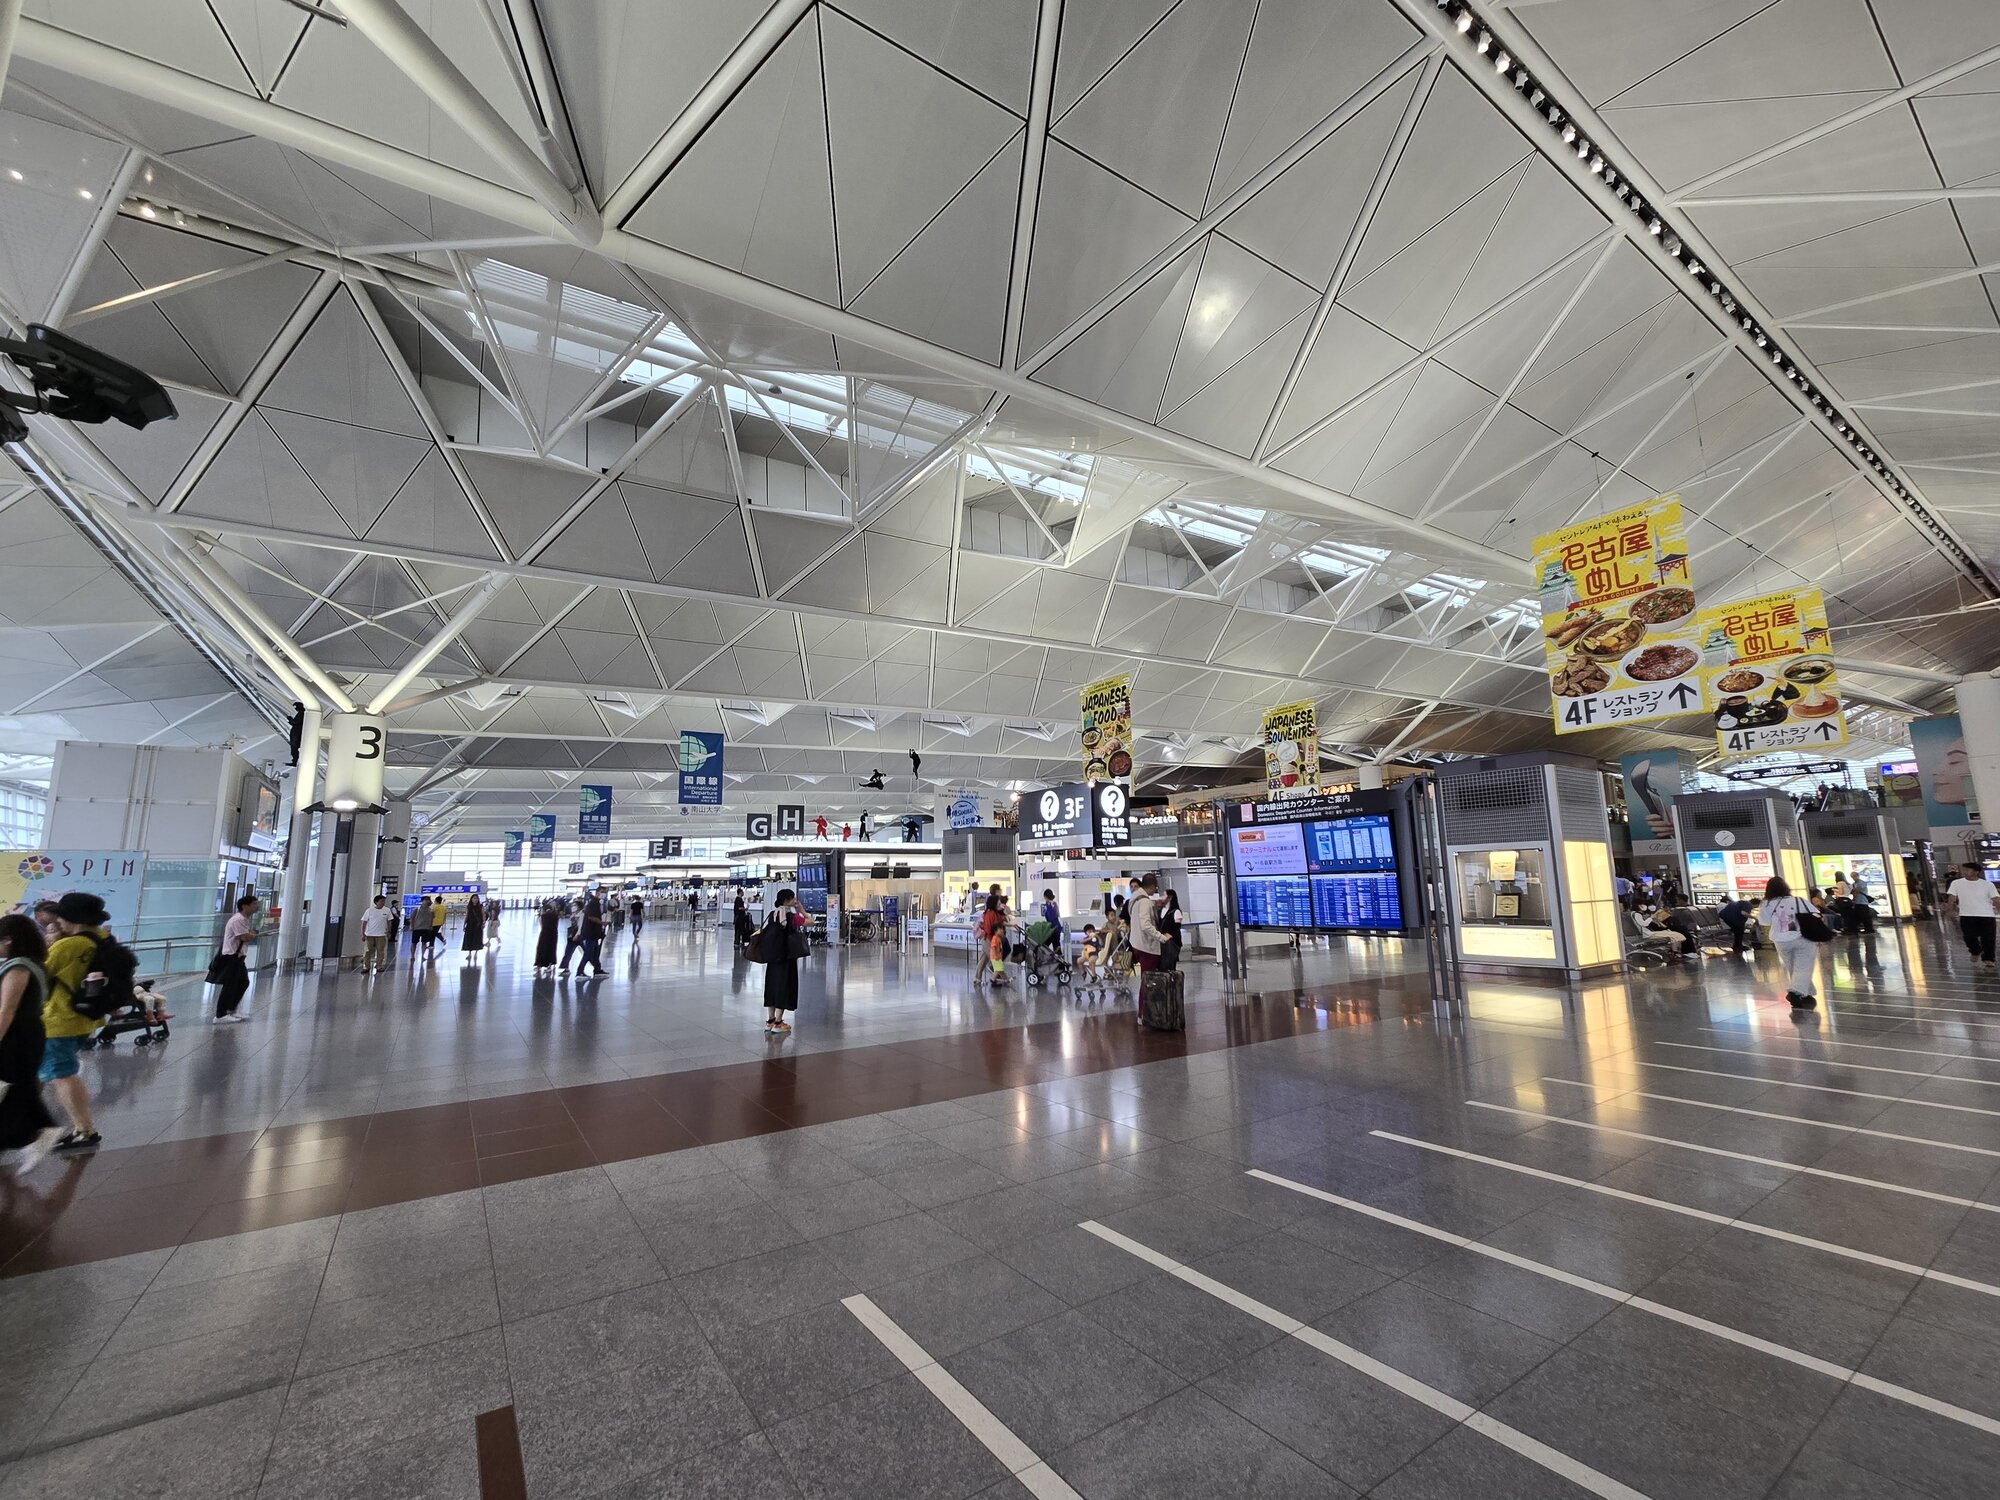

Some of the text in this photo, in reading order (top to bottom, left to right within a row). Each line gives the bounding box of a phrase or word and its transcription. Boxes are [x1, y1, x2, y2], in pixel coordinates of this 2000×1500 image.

[1560, 522, 1653, 573] 名古屋
[1586, 562, 1640, 596] めし
[1579, 586, 1645, 607] NAGOYA GOURMET
[1721, 603, 1800, 637] 名古屋
[1744, 631, 1789, 655] めし
[1082, 685, 1127, 712] JAPANESE
[1603, 691, 1664, 709] レストラン
[1092, 707, 1118, 726] FOOD
[1565, 698, 1597, 725] 4F
[1609, 701, 1659, 718] ショップ
[1265, 709, 1314, 731] JAPANESE
[355, 726, 381, 759] 3
[1267, 723, 1313, 745] SOUVENIRS
[1728, 731, 1755, 751] 4F
[1760, 726, 1811, 739] レストラン
[1766, 735, 1806, 746] ショップ
[1064, 797, 1084, 820] 3F
[1313, 804, 1340, 812] Information
[750, 817, 769, 837] G
[781, 809, 800, 831] H
[409, 836, 418, 850] 3
[653, 842, 663, 857] E
[668, 839, 679, 854] F
[61, 858, 135, 877] SPTM
[575, 863, 583, 872] B
[609, 854, 619, 866] D
